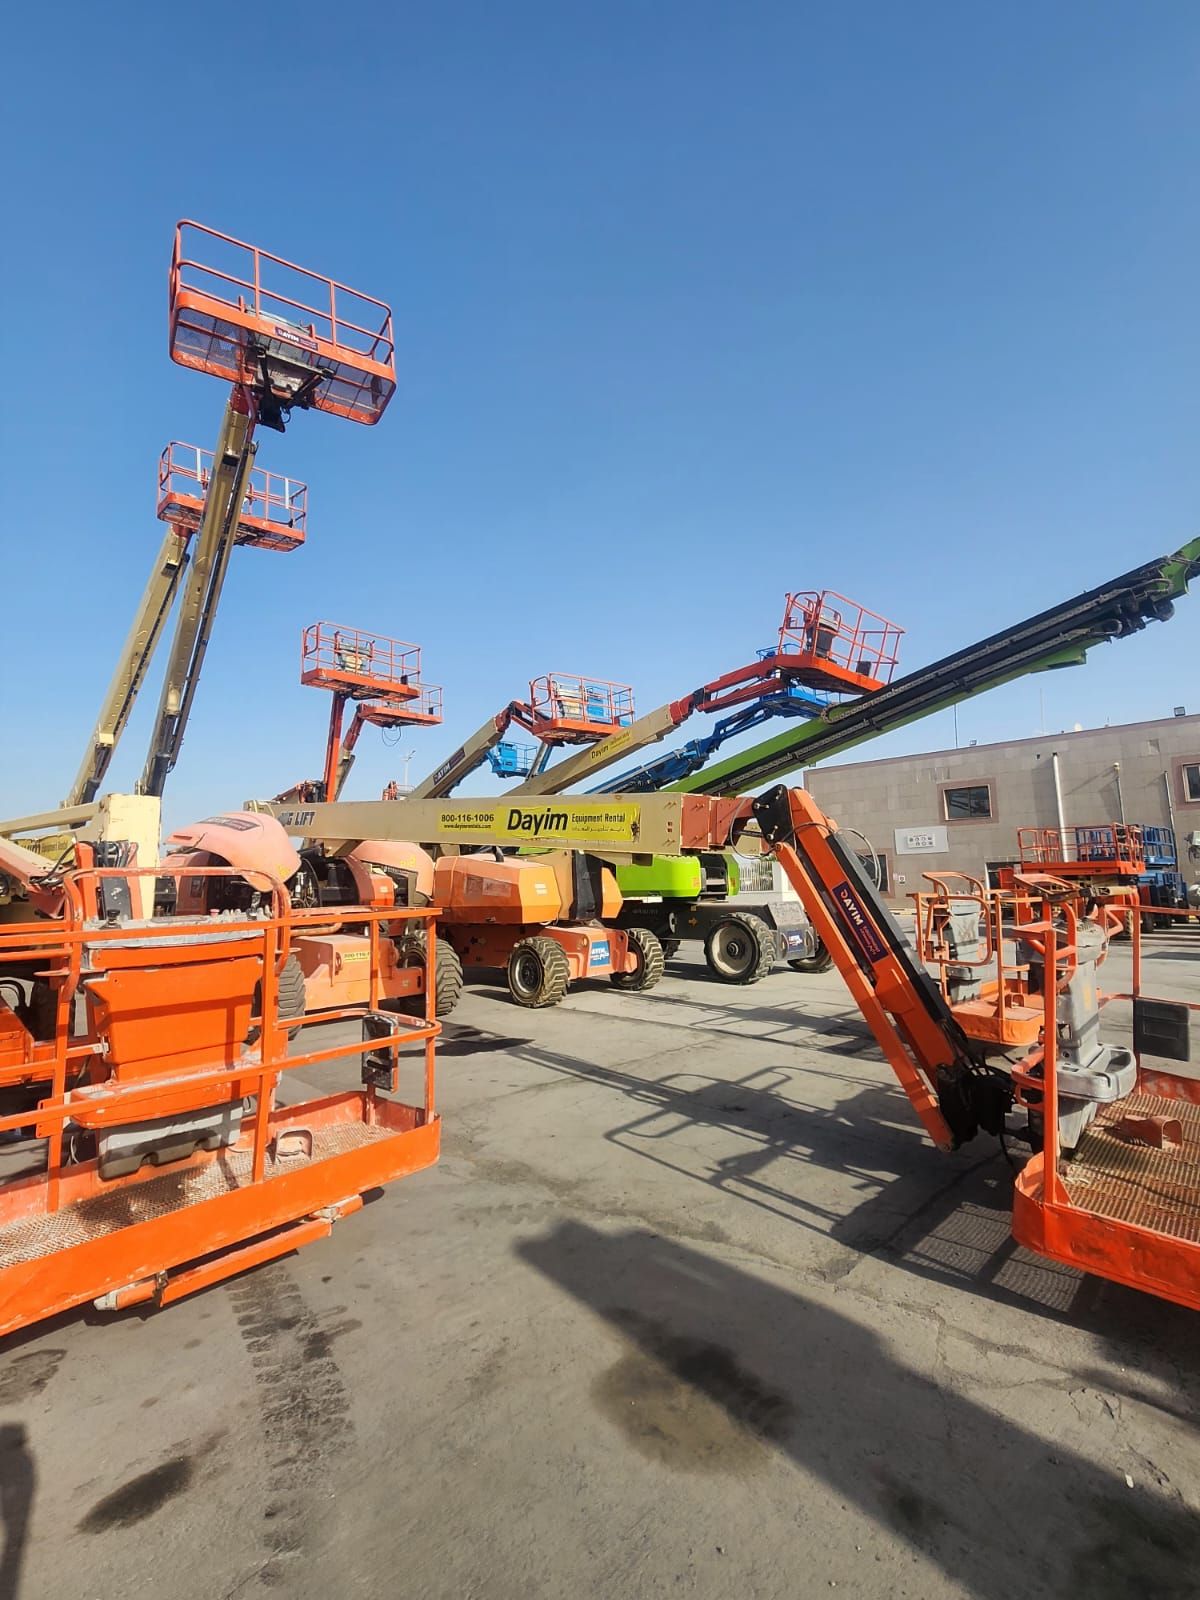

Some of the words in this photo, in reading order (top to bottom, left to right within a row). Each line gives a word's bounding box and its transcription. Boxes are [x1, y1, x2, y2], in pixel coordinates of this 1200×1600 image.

[295, 811, 315, 826] LIFT
[441, 814, 494, 822] 800-116-1006
[507, 808, 568, 836] Dayim
[571, 813, 603, 824] Equipment
[604, 812, 626, 823] Rental
[840, 889, 864, 926] DAYIM
